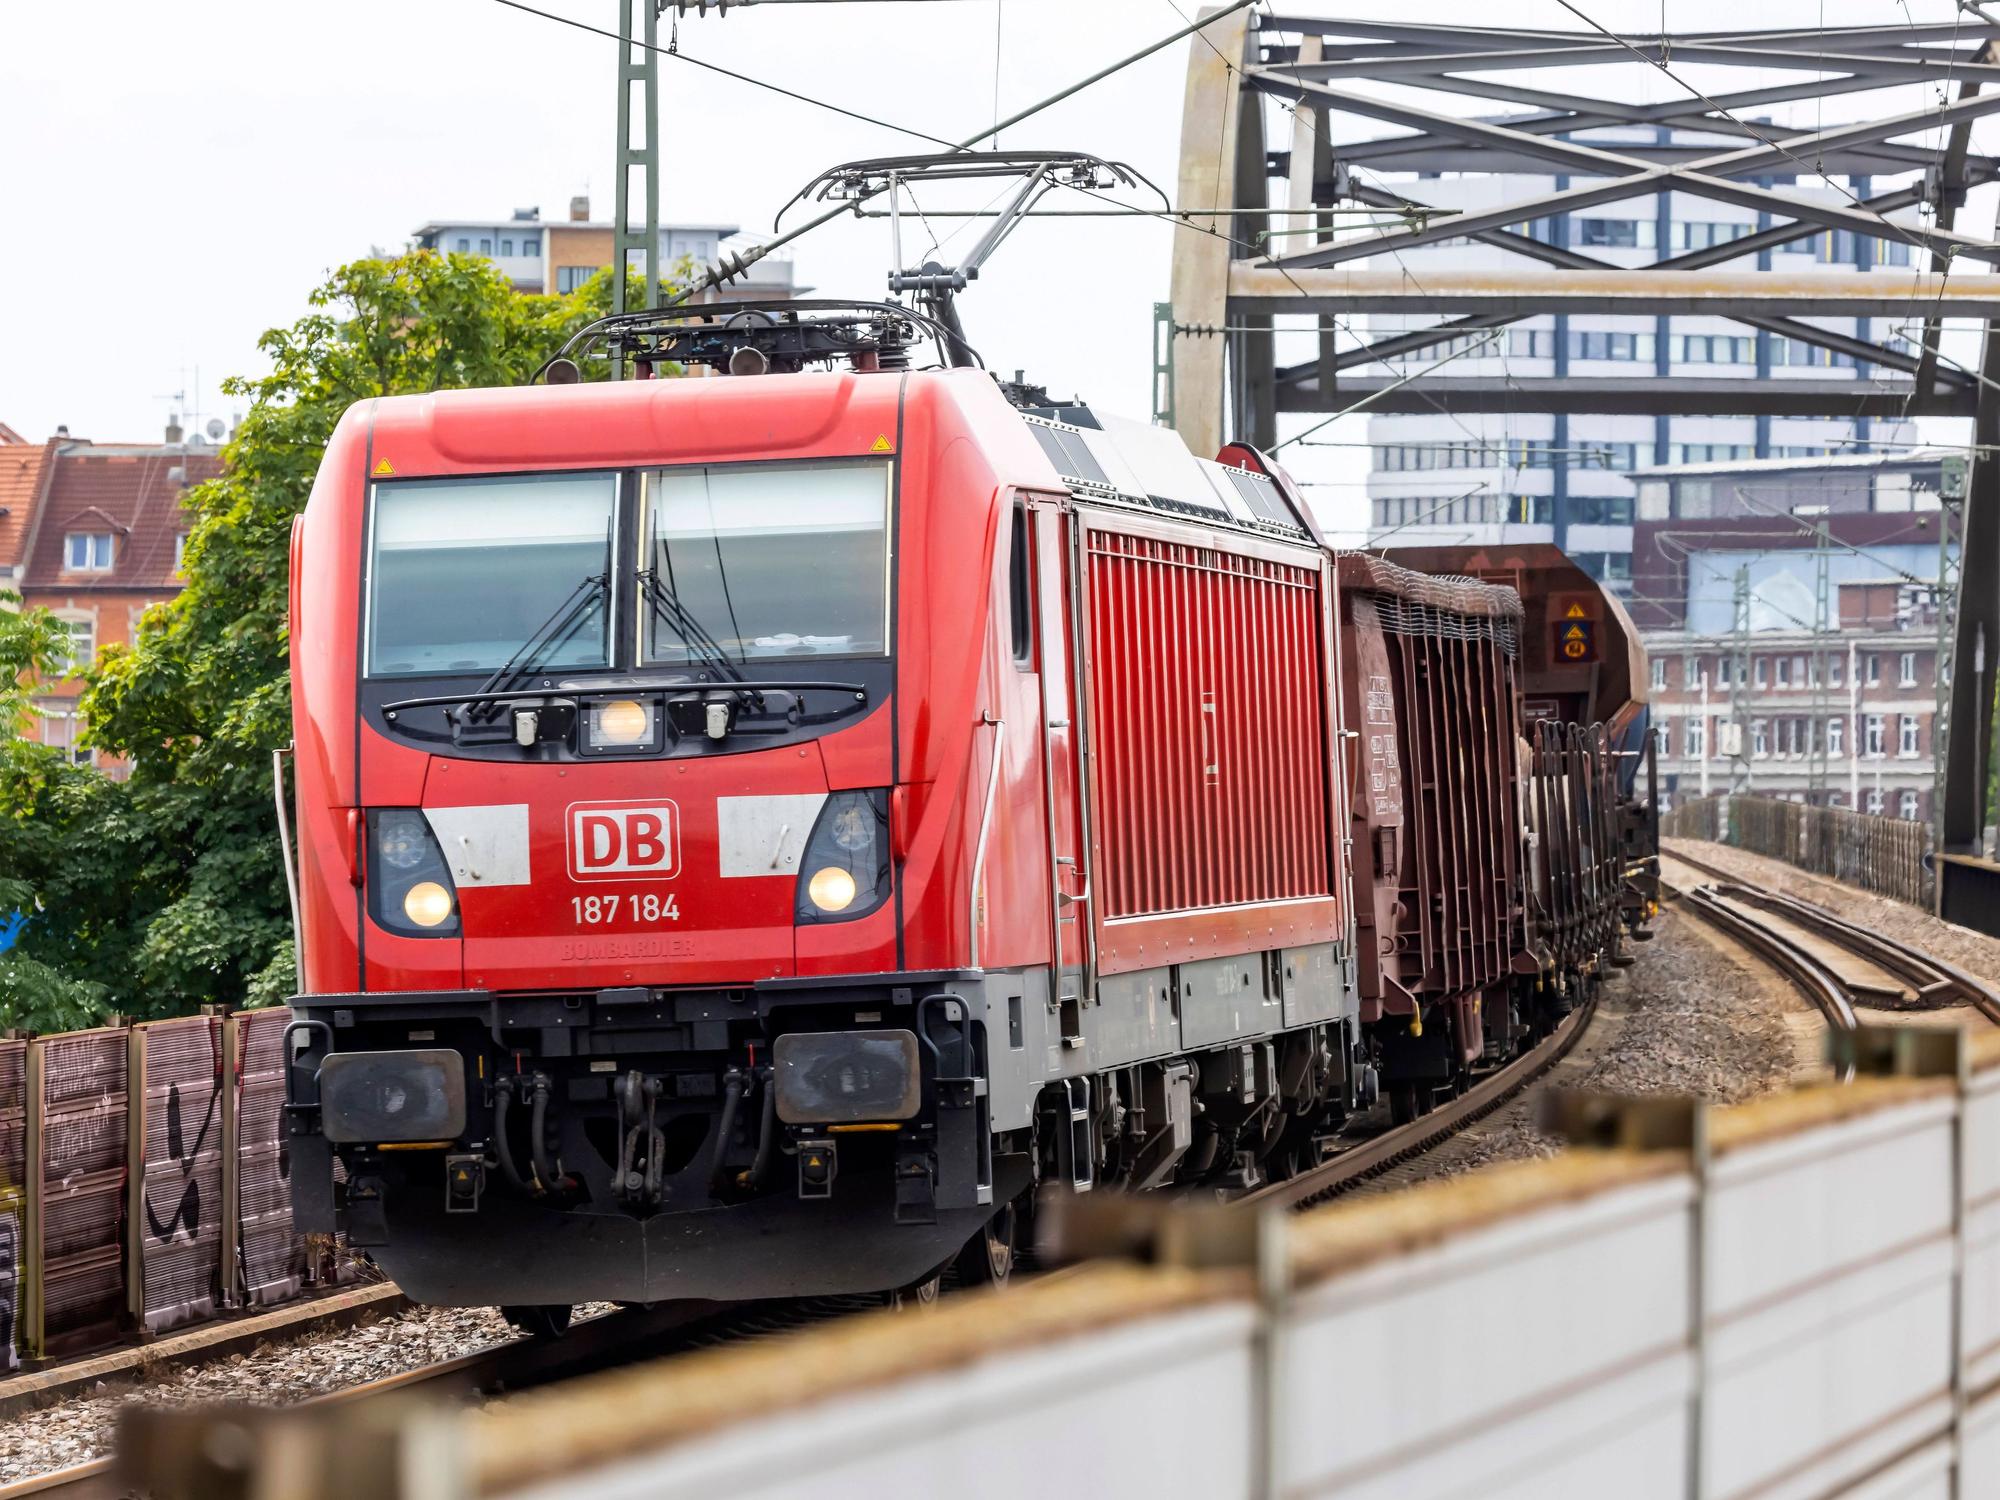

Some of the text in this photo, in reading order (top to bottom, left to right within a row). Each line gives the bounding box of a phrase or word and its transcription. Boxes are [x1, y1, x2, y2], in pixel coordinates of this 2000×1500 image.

[582, 814, 665, 867] DB
[571, 893, 680, 924] 187 184
[561, 939, 696, 961] BOMBARDIER
